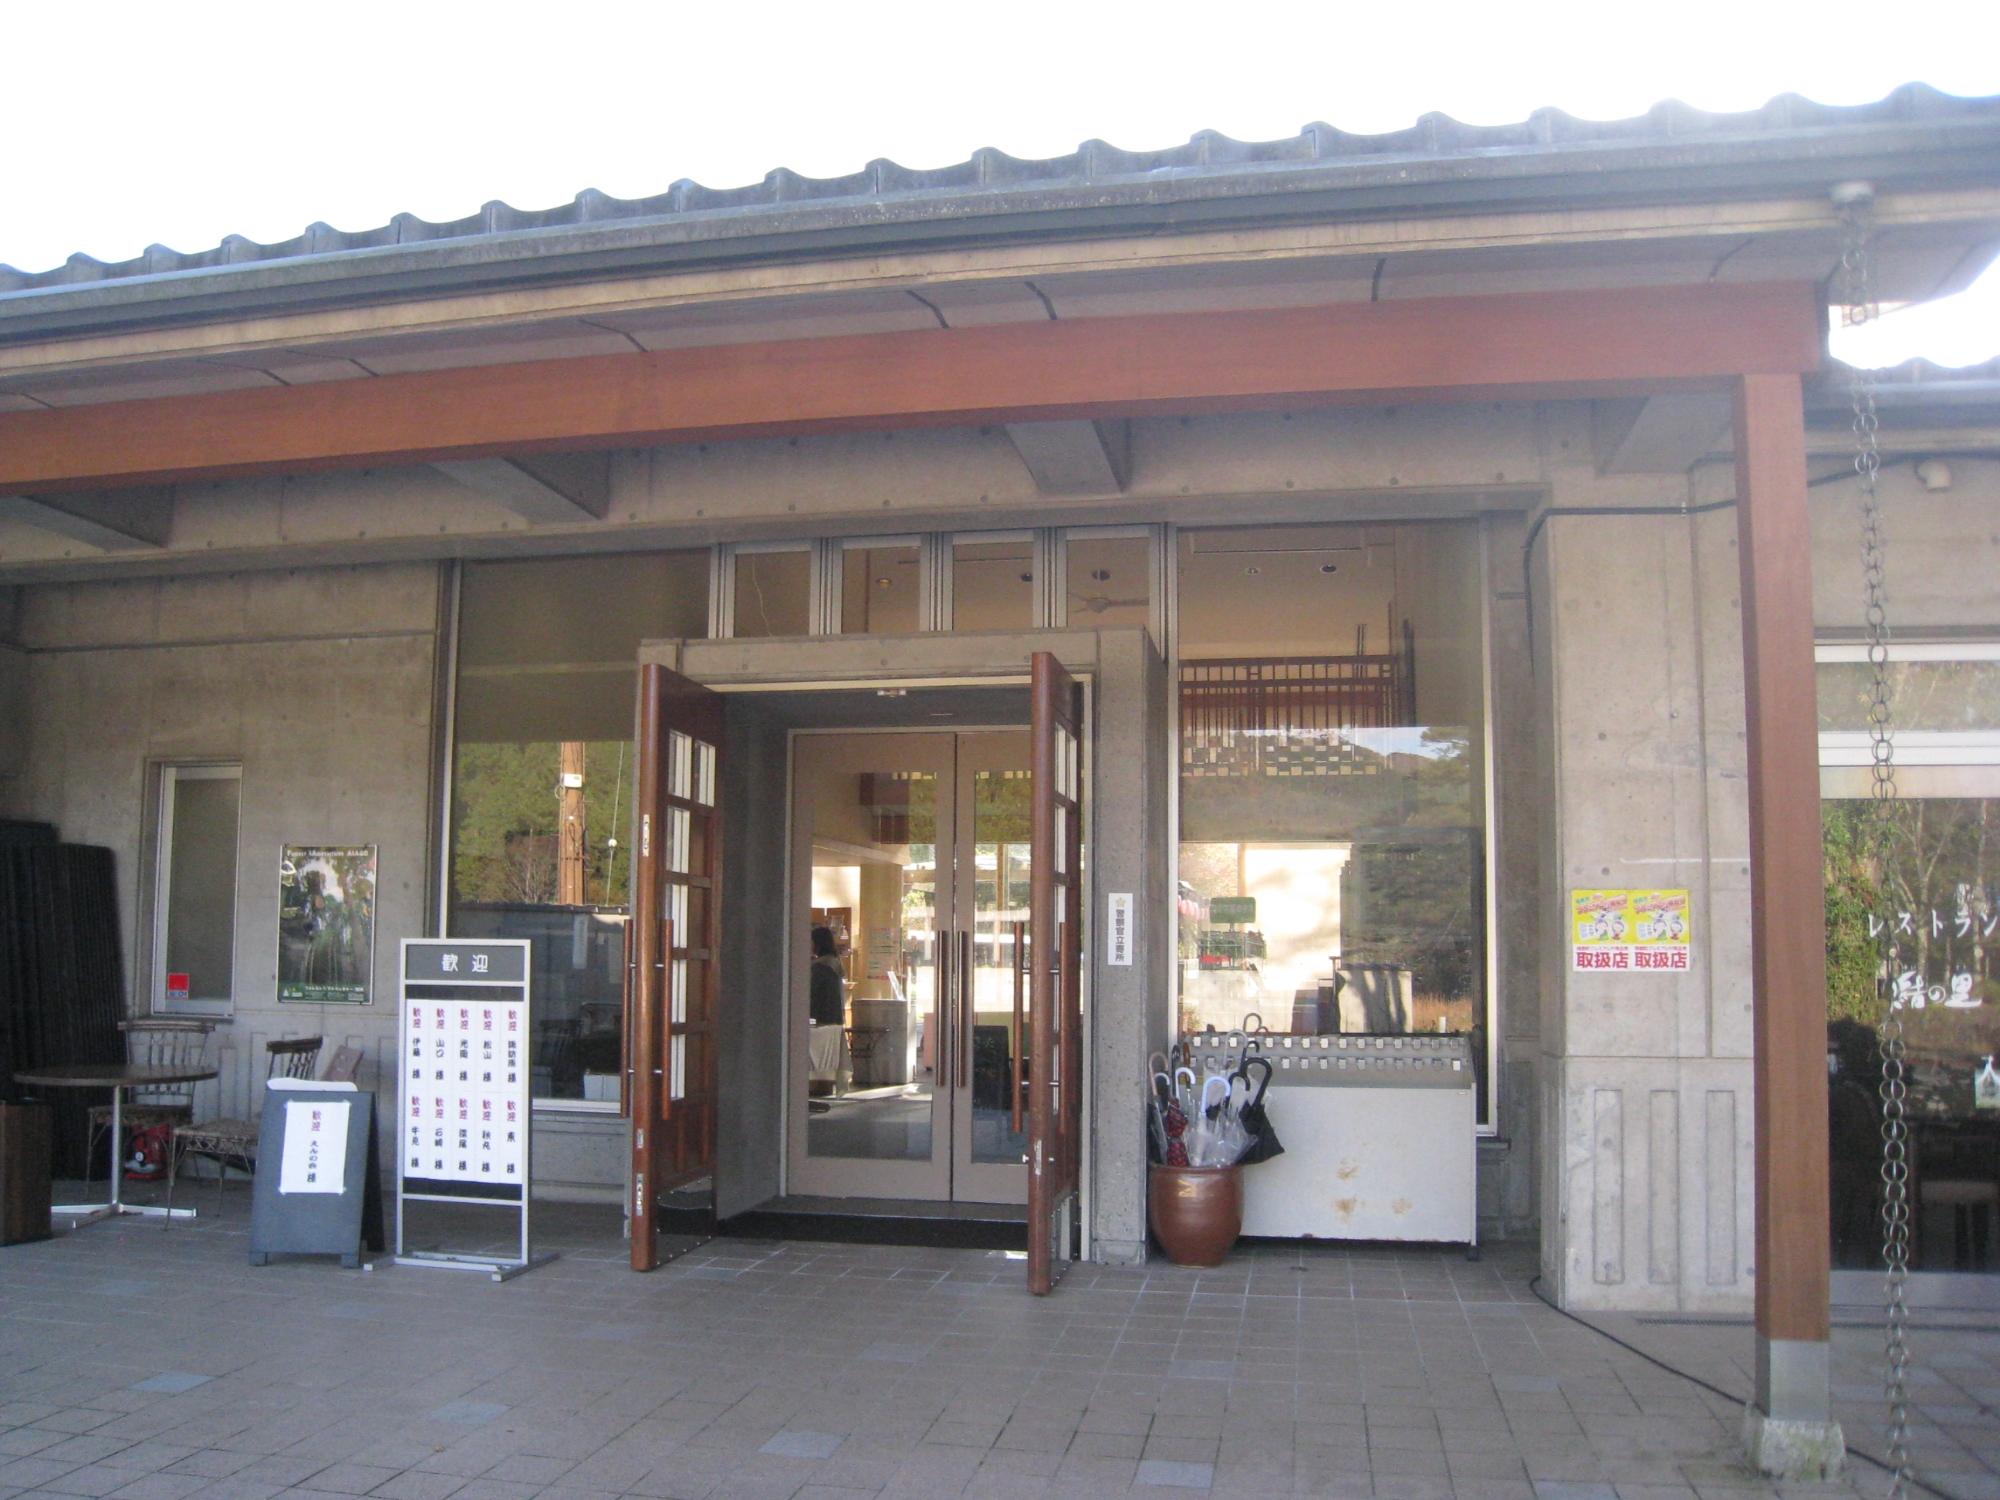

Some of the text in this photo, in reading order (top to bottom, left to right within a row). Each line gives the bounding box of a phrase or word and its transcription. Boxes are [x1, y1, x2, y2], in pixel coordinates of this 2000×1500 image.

[1868, 909, 1998, 938] レストラン
[441, 954, 488, 972] 歓迎
[1576, 951, 1629, 968] 取扱店
[1635, 951, 1687, 968] 取扱店
